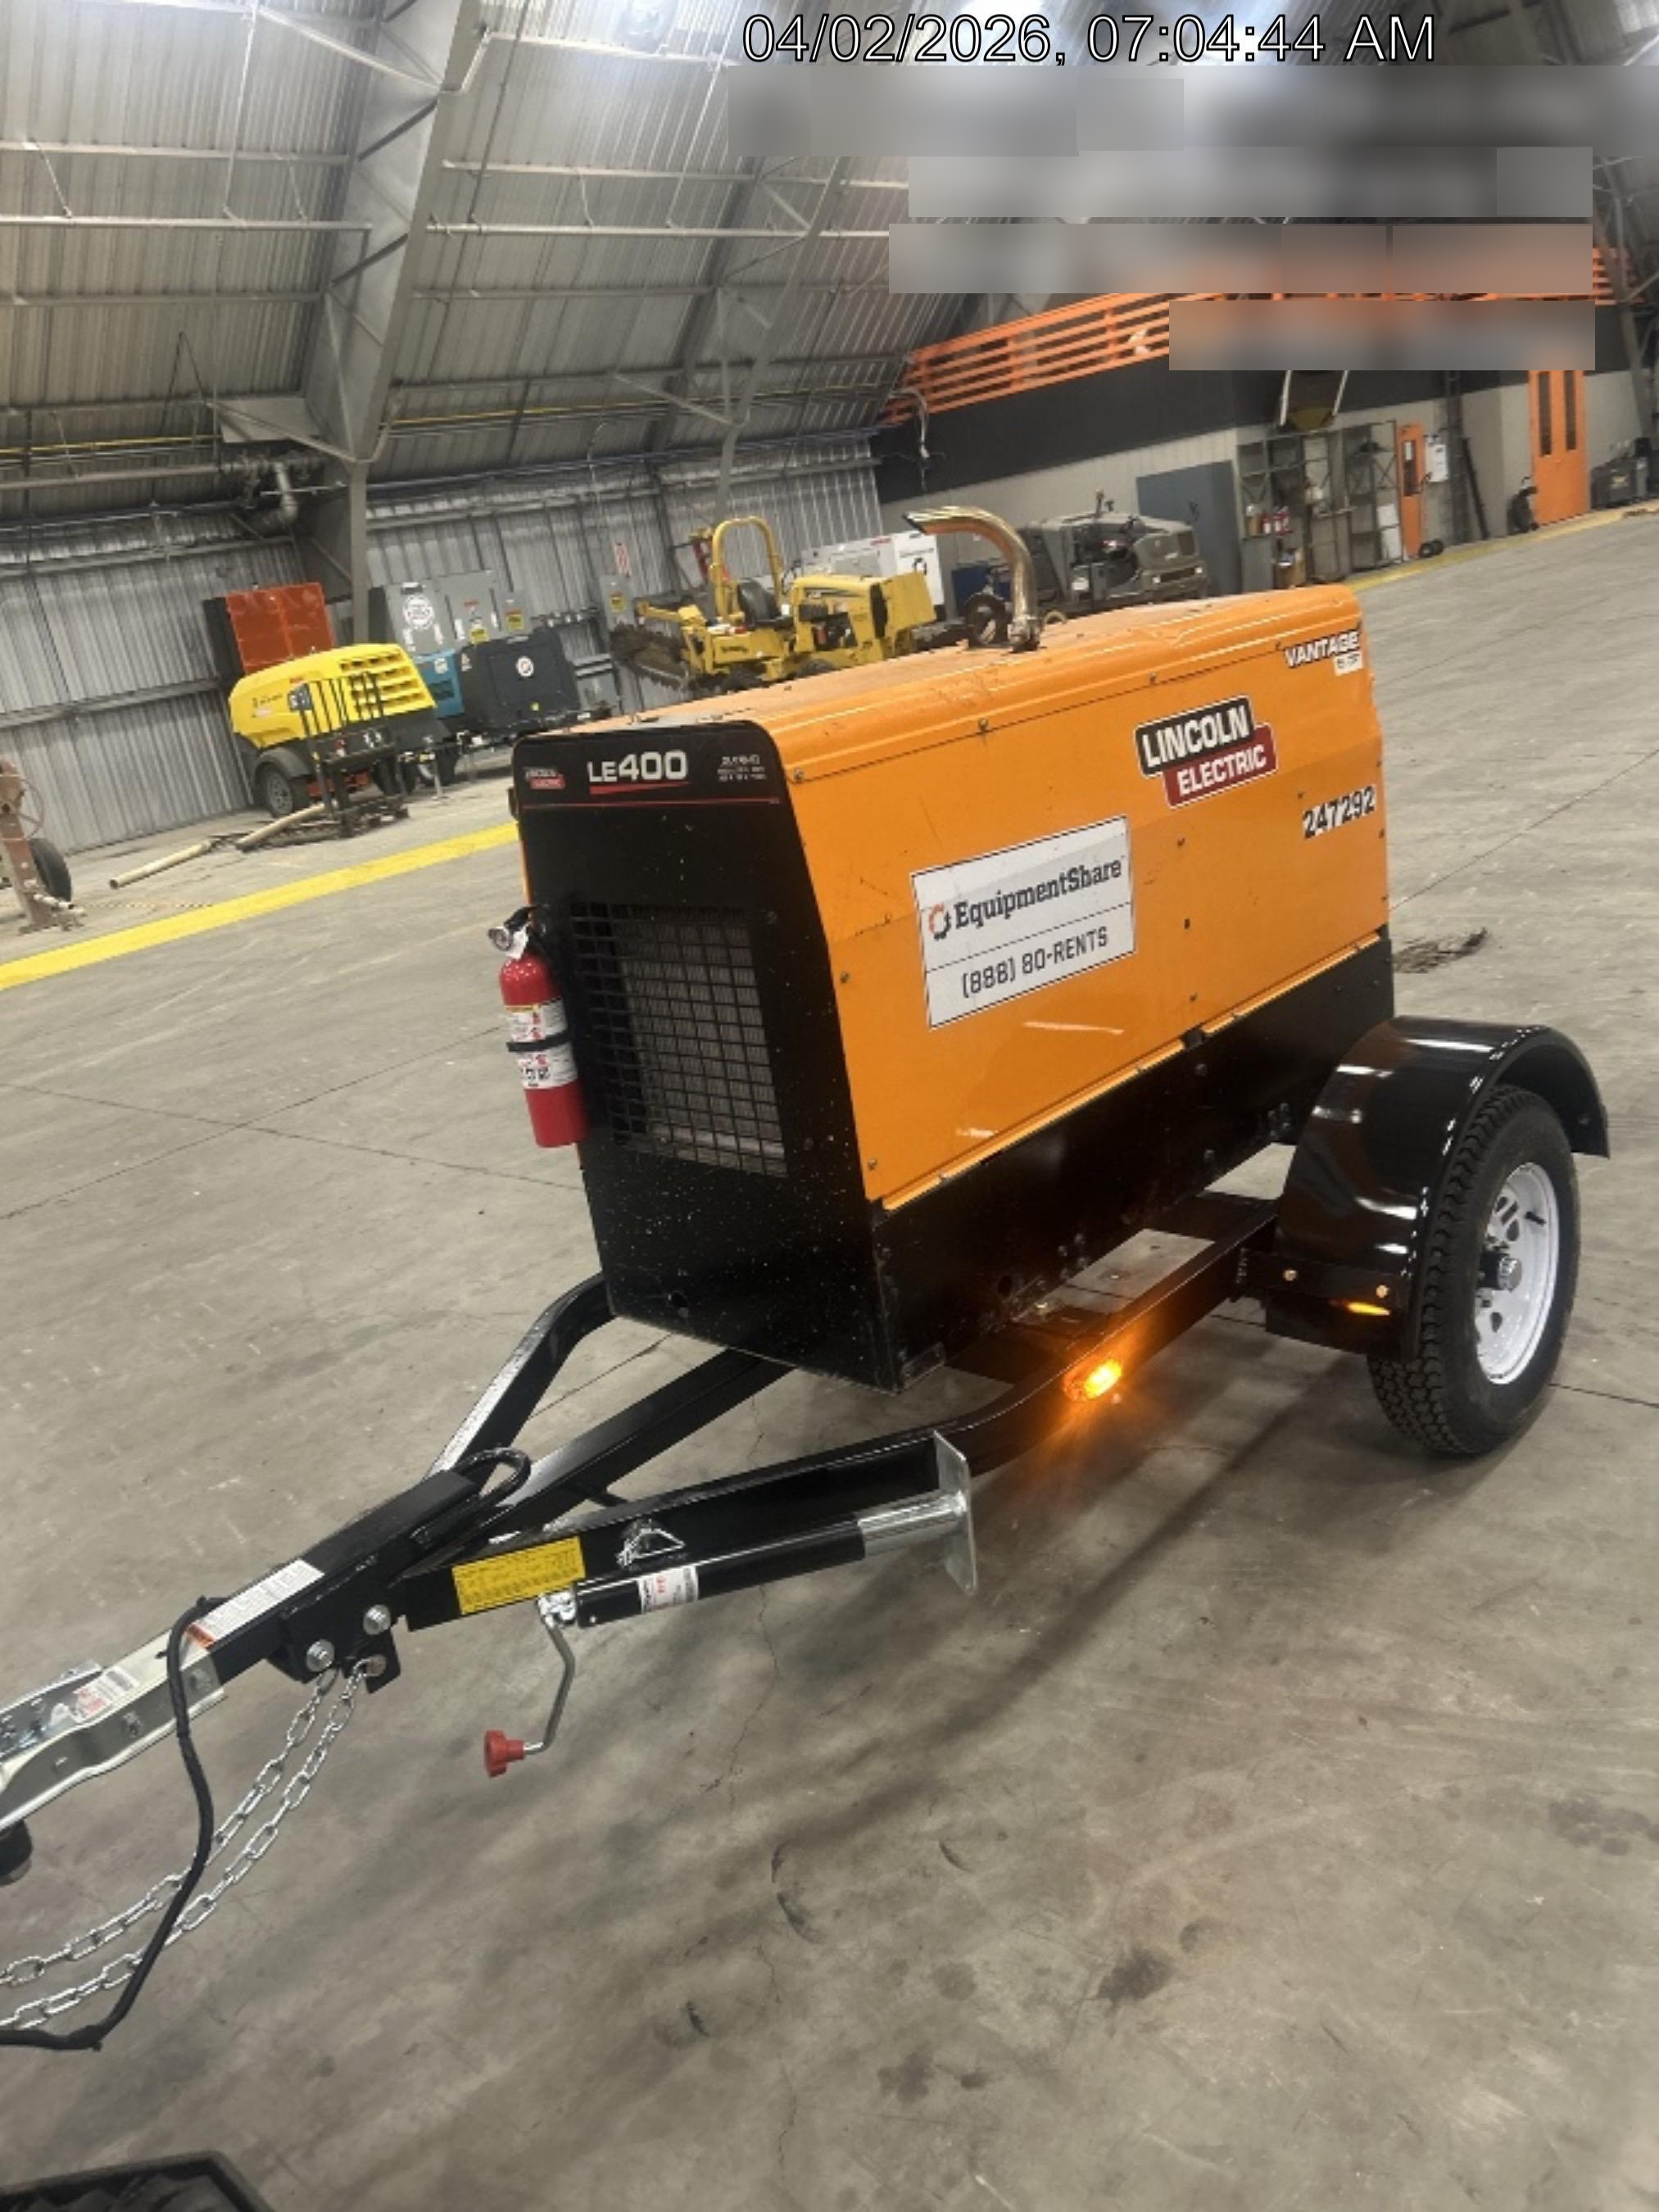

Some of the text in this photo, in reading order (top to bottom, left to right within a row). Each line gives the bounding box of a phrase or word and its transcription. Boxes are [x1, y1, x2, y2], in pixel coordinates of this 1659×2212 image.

[1284, 629, 1360, 669] VANTAGE
[1143, 705, 1250, 768] LINCOLN
[587, 750, 687, 783] LE400
[1176, 745, 1267, 796] ELECTRIC
[1302, 786, 1376, 839] 247292
[954, 858, 1122, 930] EquipmentShare
[962, 926, 1108, 998] (888) 80-RENTS
